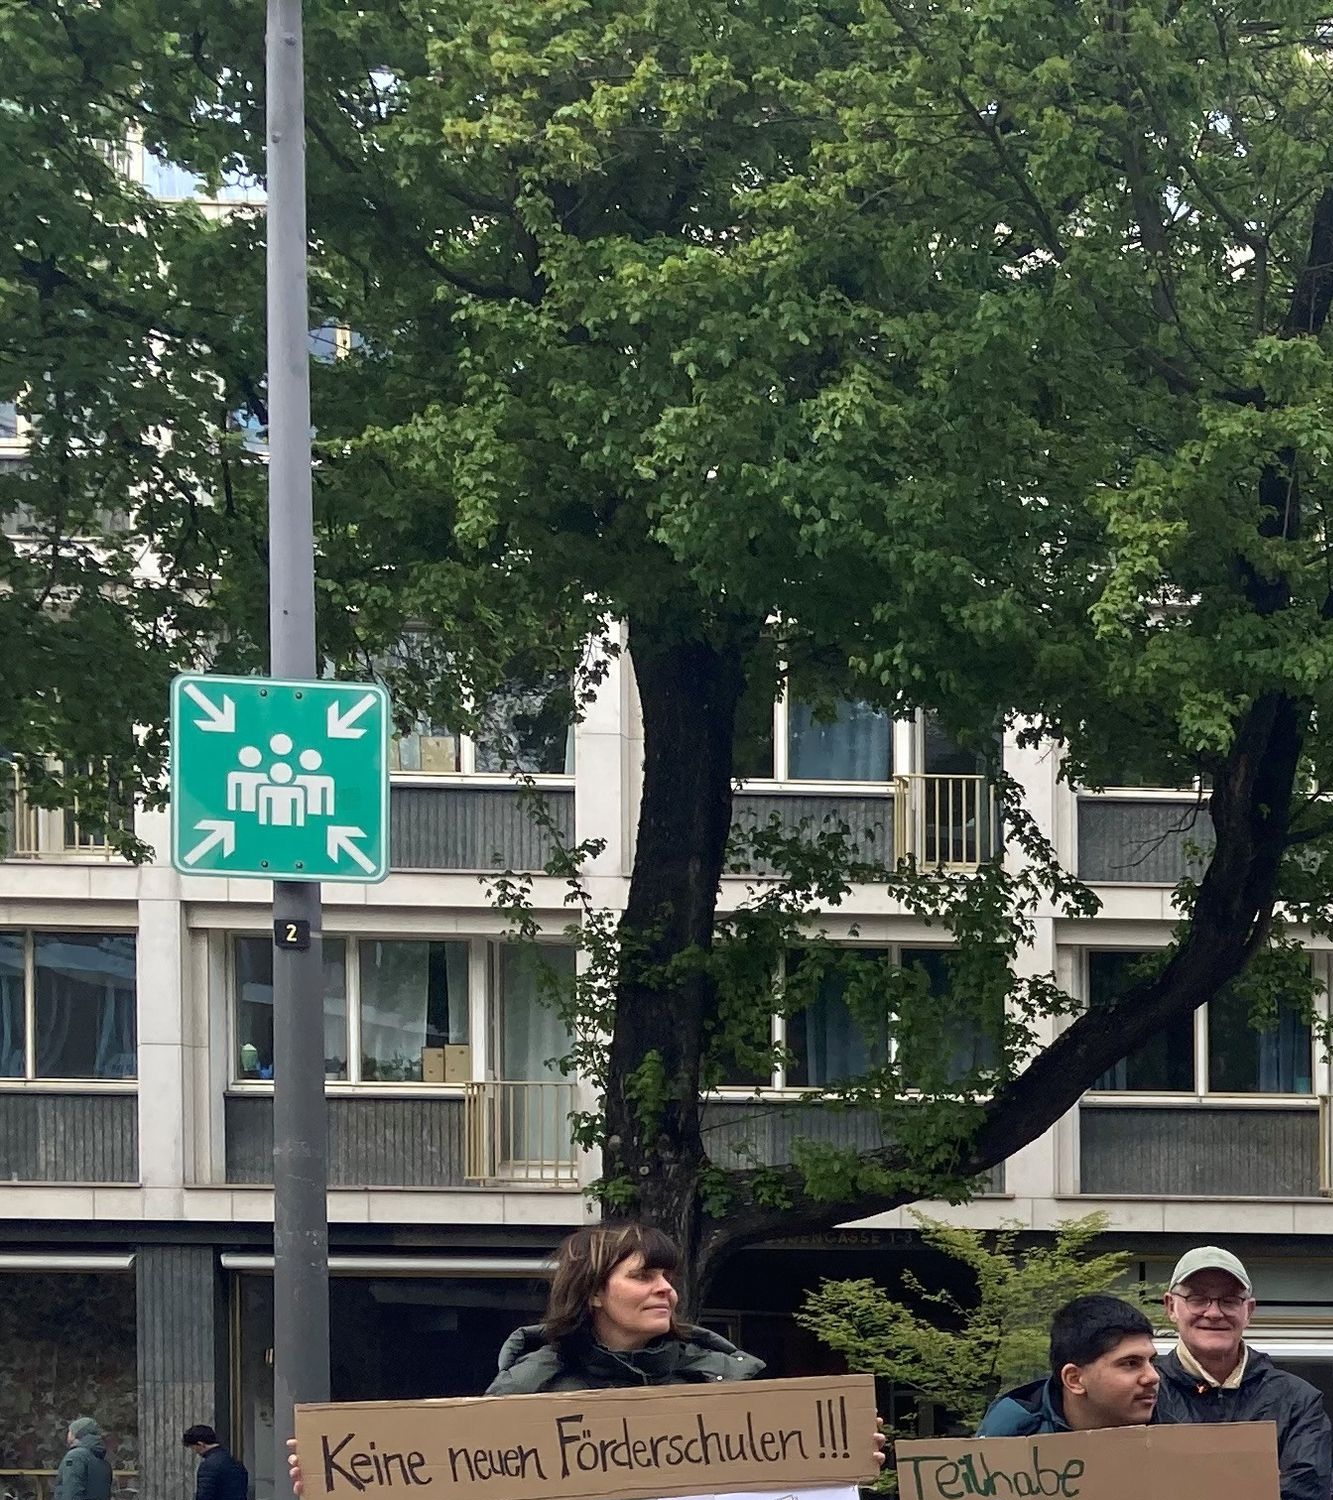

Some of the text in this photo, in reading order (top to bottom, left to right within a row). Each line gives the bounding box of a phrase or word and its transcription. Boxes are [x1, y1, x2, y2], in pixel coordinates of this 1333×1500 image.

[286, 923, 298, 942] 2
[321, 1432, 433, 1493] Keine
[448, 1445, 548, 1482] neuen
